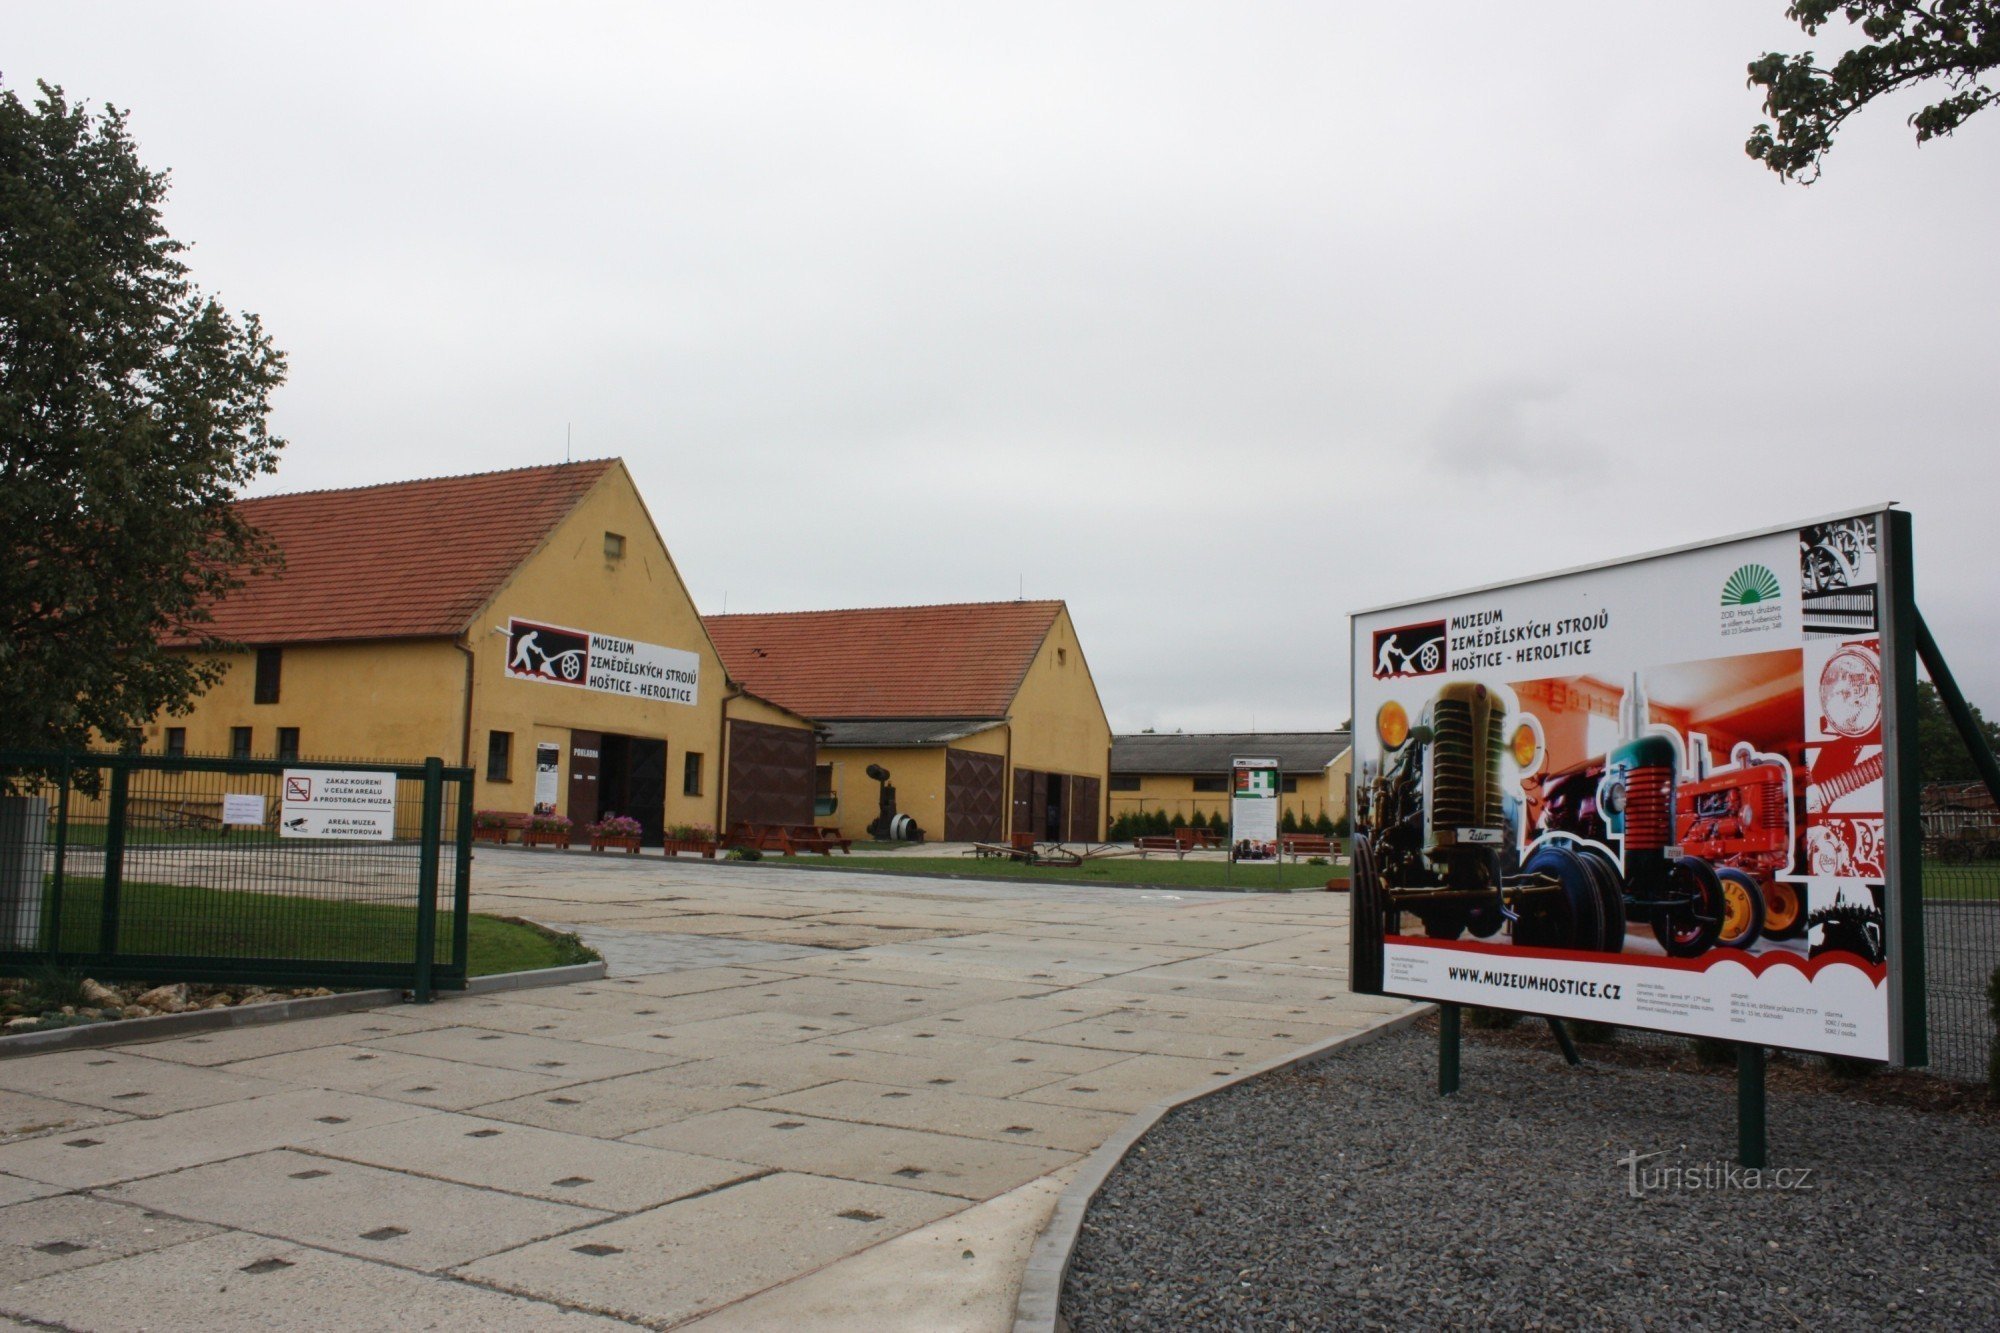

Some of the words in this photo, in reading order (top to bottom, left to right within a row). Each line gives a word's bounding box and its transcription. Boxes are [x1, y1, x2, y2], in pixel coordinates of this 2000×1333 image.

[1451, 609, 1503, 631] MUZEUM
[1451, 620, 1551, 651] ZEMĚDĚLSKÝCH
[1556, 608, 1608, 636] STROJŮ
[592, 636, 634, 655] MUZEUM
[1452, 652, 1503, 672] HOŠTICE
[1516, 639, 1592, 663] HEROLTICE
[590, 655, 663, 679] ZEMĚDĚLSKÝCH
[665, 669, 697, 685] STROJŮ
[589, 674, 631, 693] HOŠTICE
[640, 683, 691, 702] HEROLTICE
[1449, 967, 1622, 1000] WWW.MUZEUMHOSTICE.CZ
